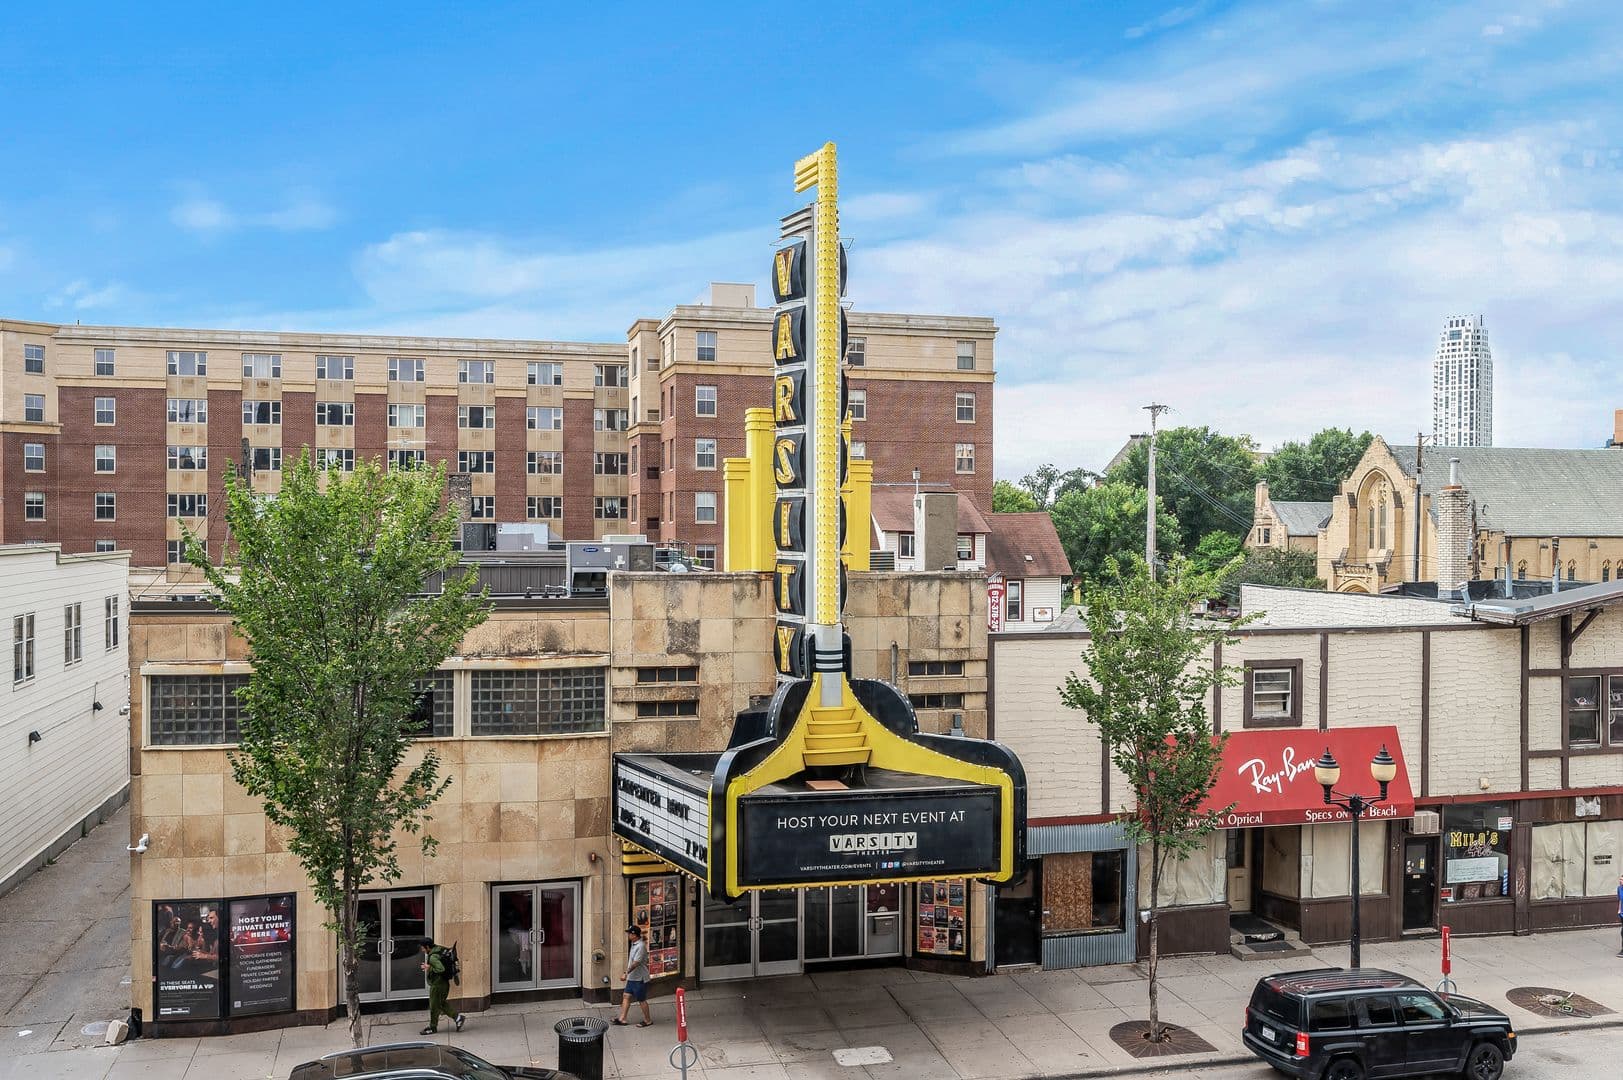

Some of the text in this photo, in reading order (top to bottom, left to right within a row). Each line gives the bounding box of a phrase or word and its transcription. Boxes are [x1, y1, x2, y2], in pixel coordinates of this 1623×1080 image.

[775, 247, 797, 673] VARSITY
[777, 810, 966, 830] HOST YOUR NEXT EVENT AT
[1228, 812, 1263, 826] Optical
[831, 834, 916, 850] VARSITY
[265, 921, 290, 929] EVENT
